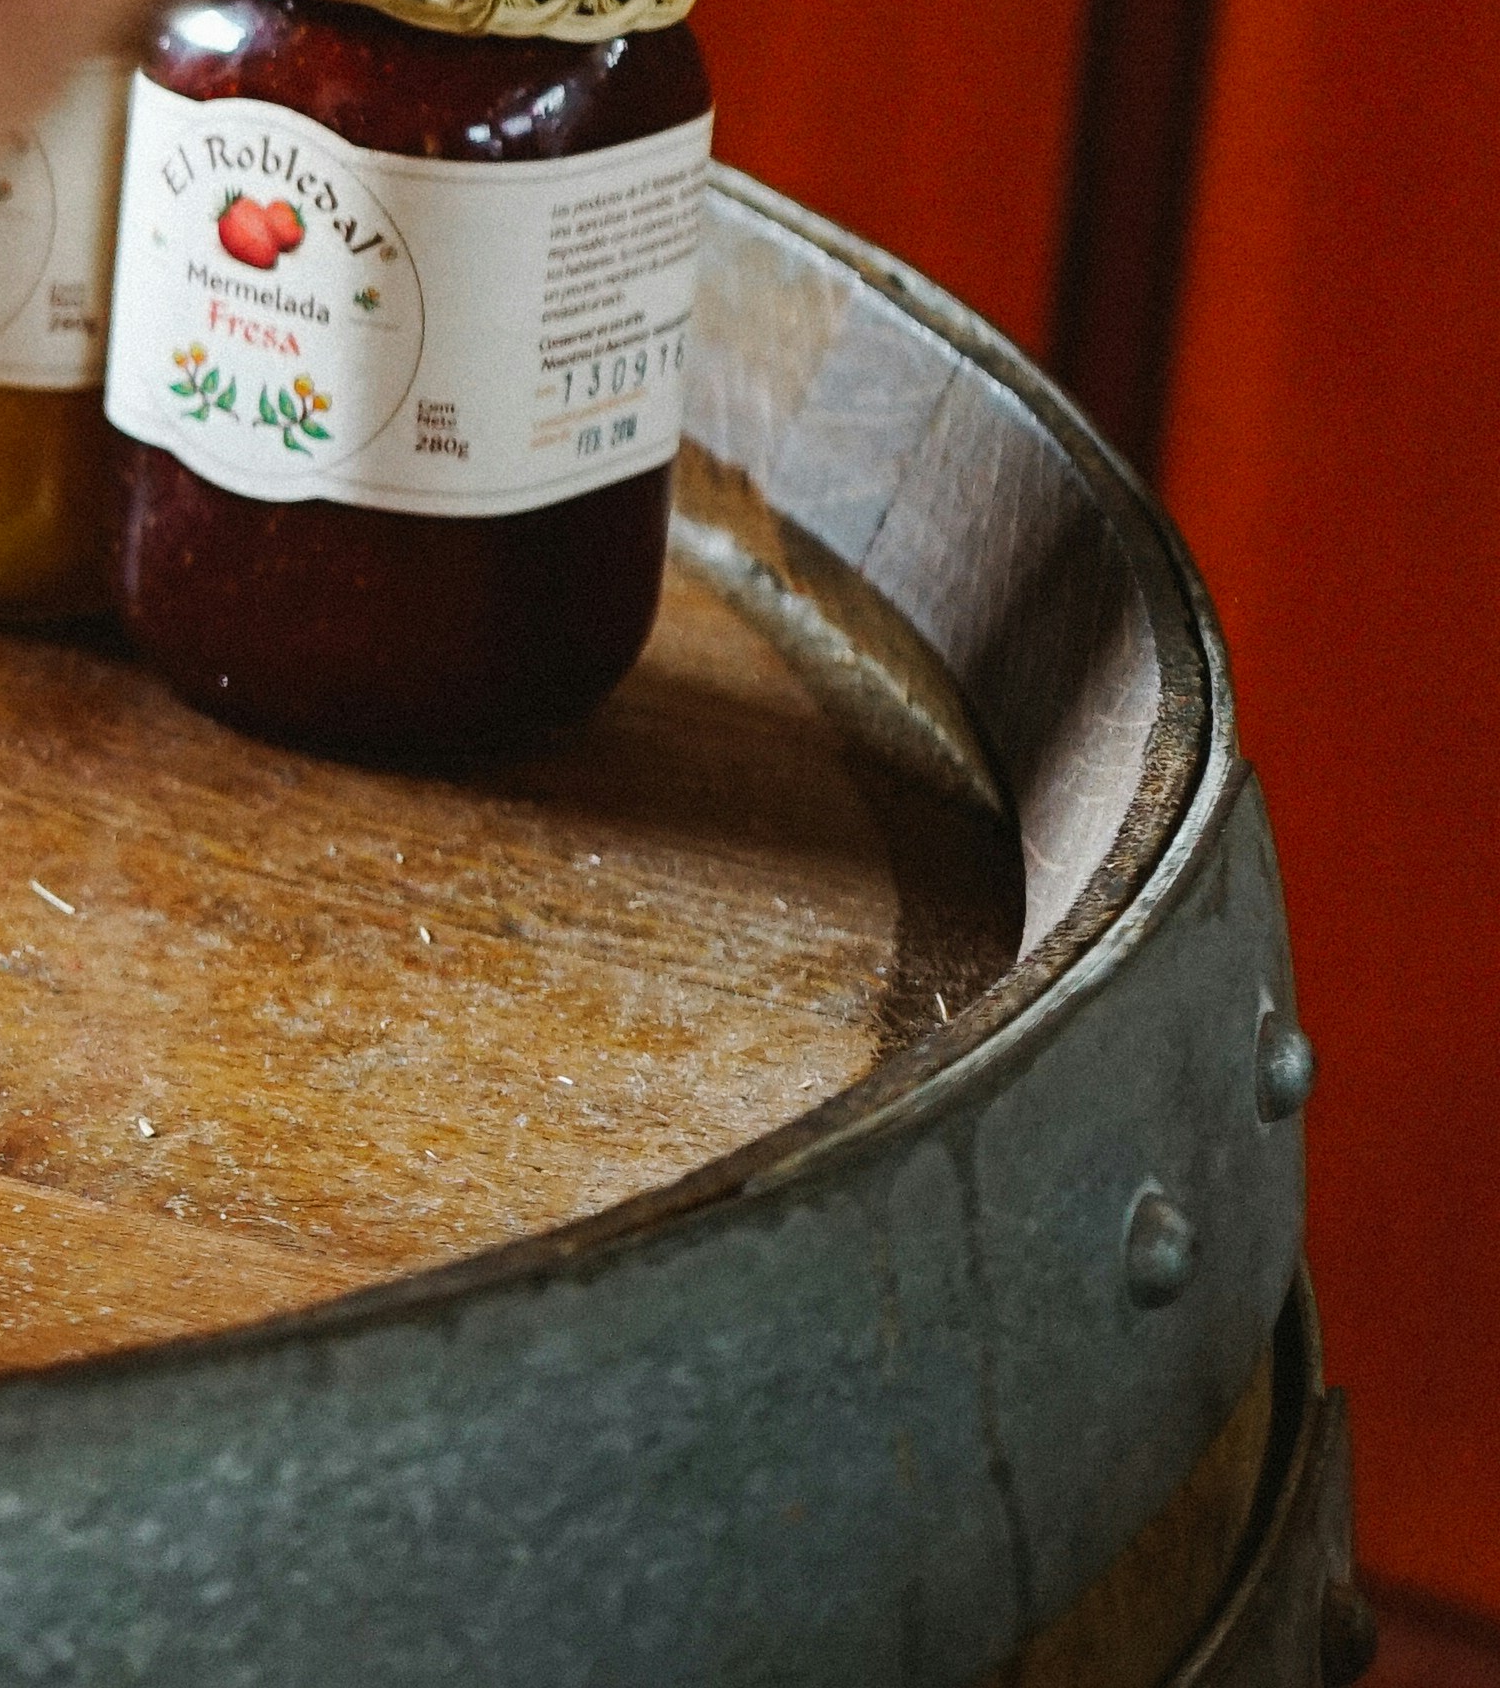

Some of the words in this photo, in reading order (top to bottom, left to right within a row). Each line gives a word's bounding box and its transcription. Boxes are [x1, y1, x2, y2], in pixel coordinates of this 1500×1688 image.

[162, 144, 195, 197] El
[187, 261, 331, 325] Mermelada
[208, 298, 301, 357] Fresa
